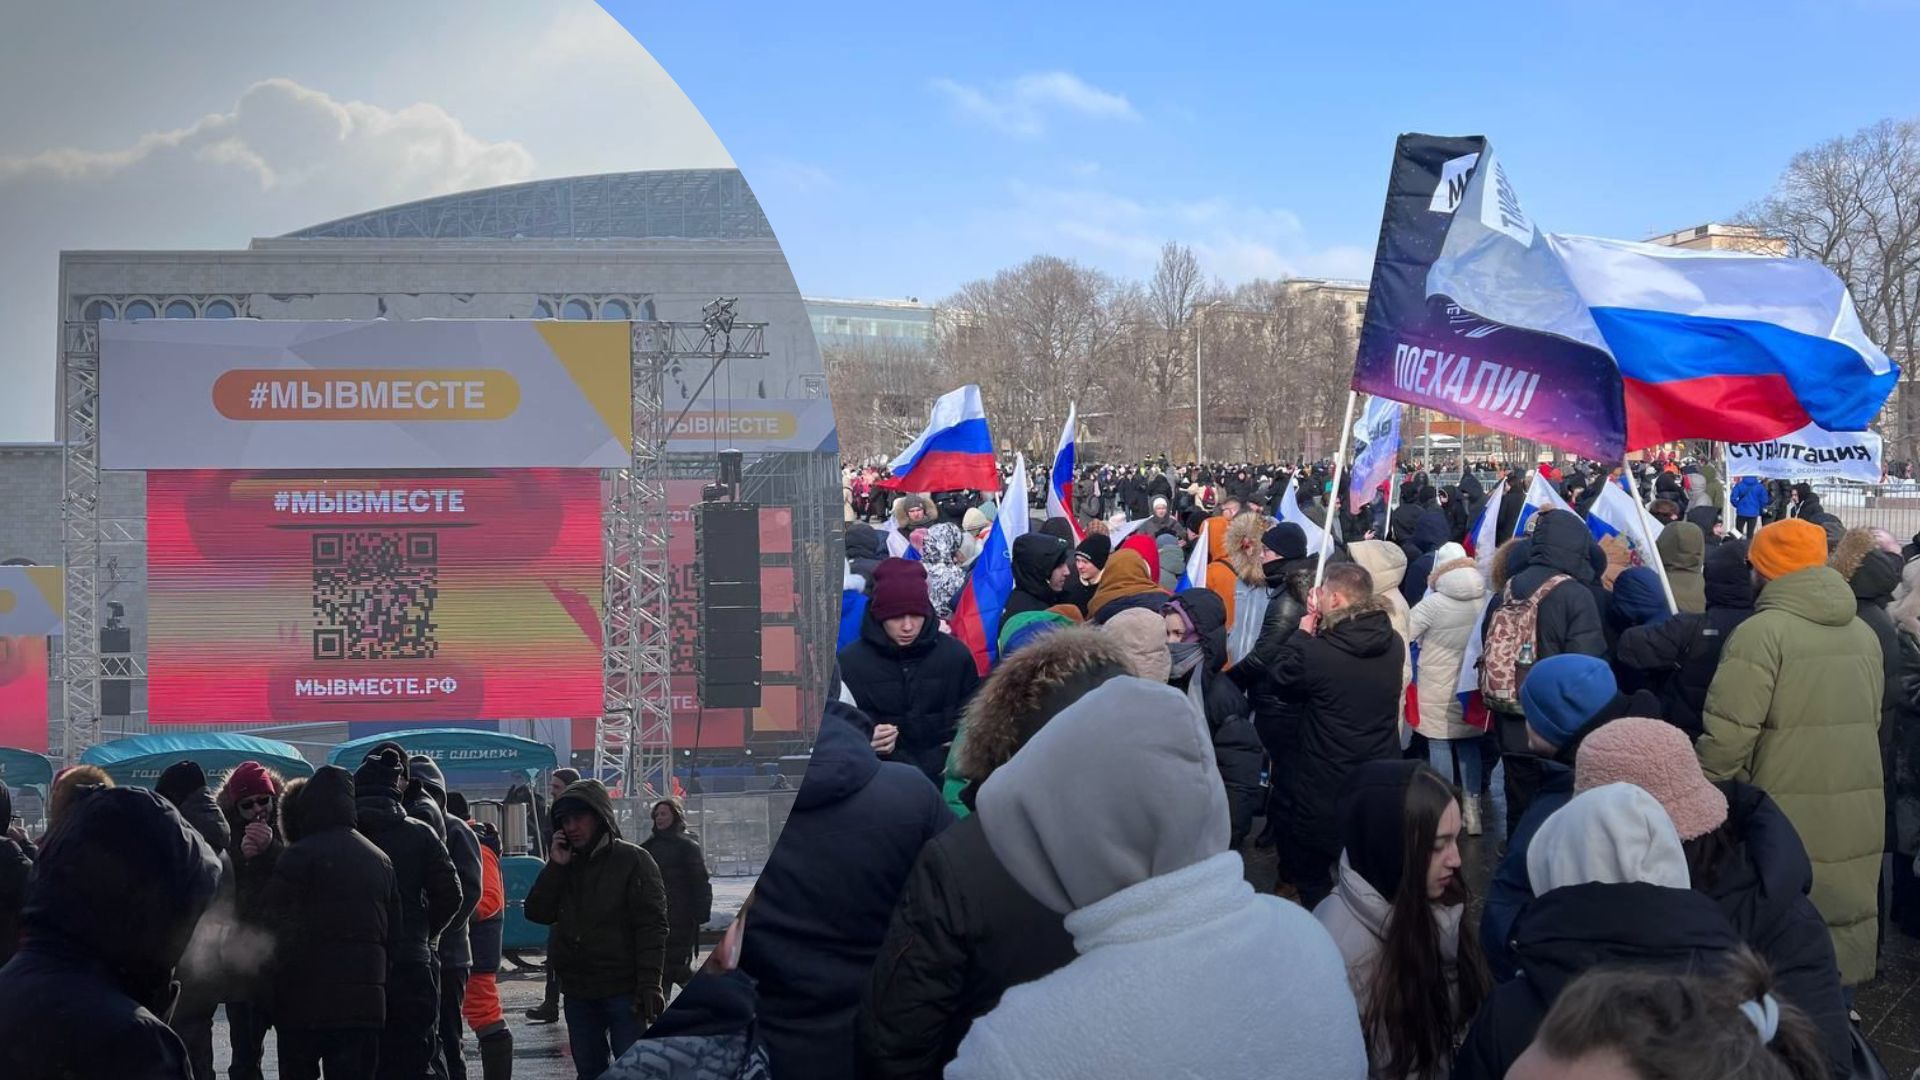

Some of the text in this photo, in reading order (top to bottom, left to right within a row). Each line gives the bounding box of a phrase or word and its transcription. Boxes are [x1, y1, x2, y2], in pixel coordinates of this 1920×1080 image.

[249, 380, 486, 409] #МЫВМЕСТЕ
[1394, 343, 1541, 419] ПОЕХАЛИ!
[274, 489, 465, 514] #МЫВМЕСТЕ
[295, 676, 458, 696] МЫВМЕСТЕ.РФ
